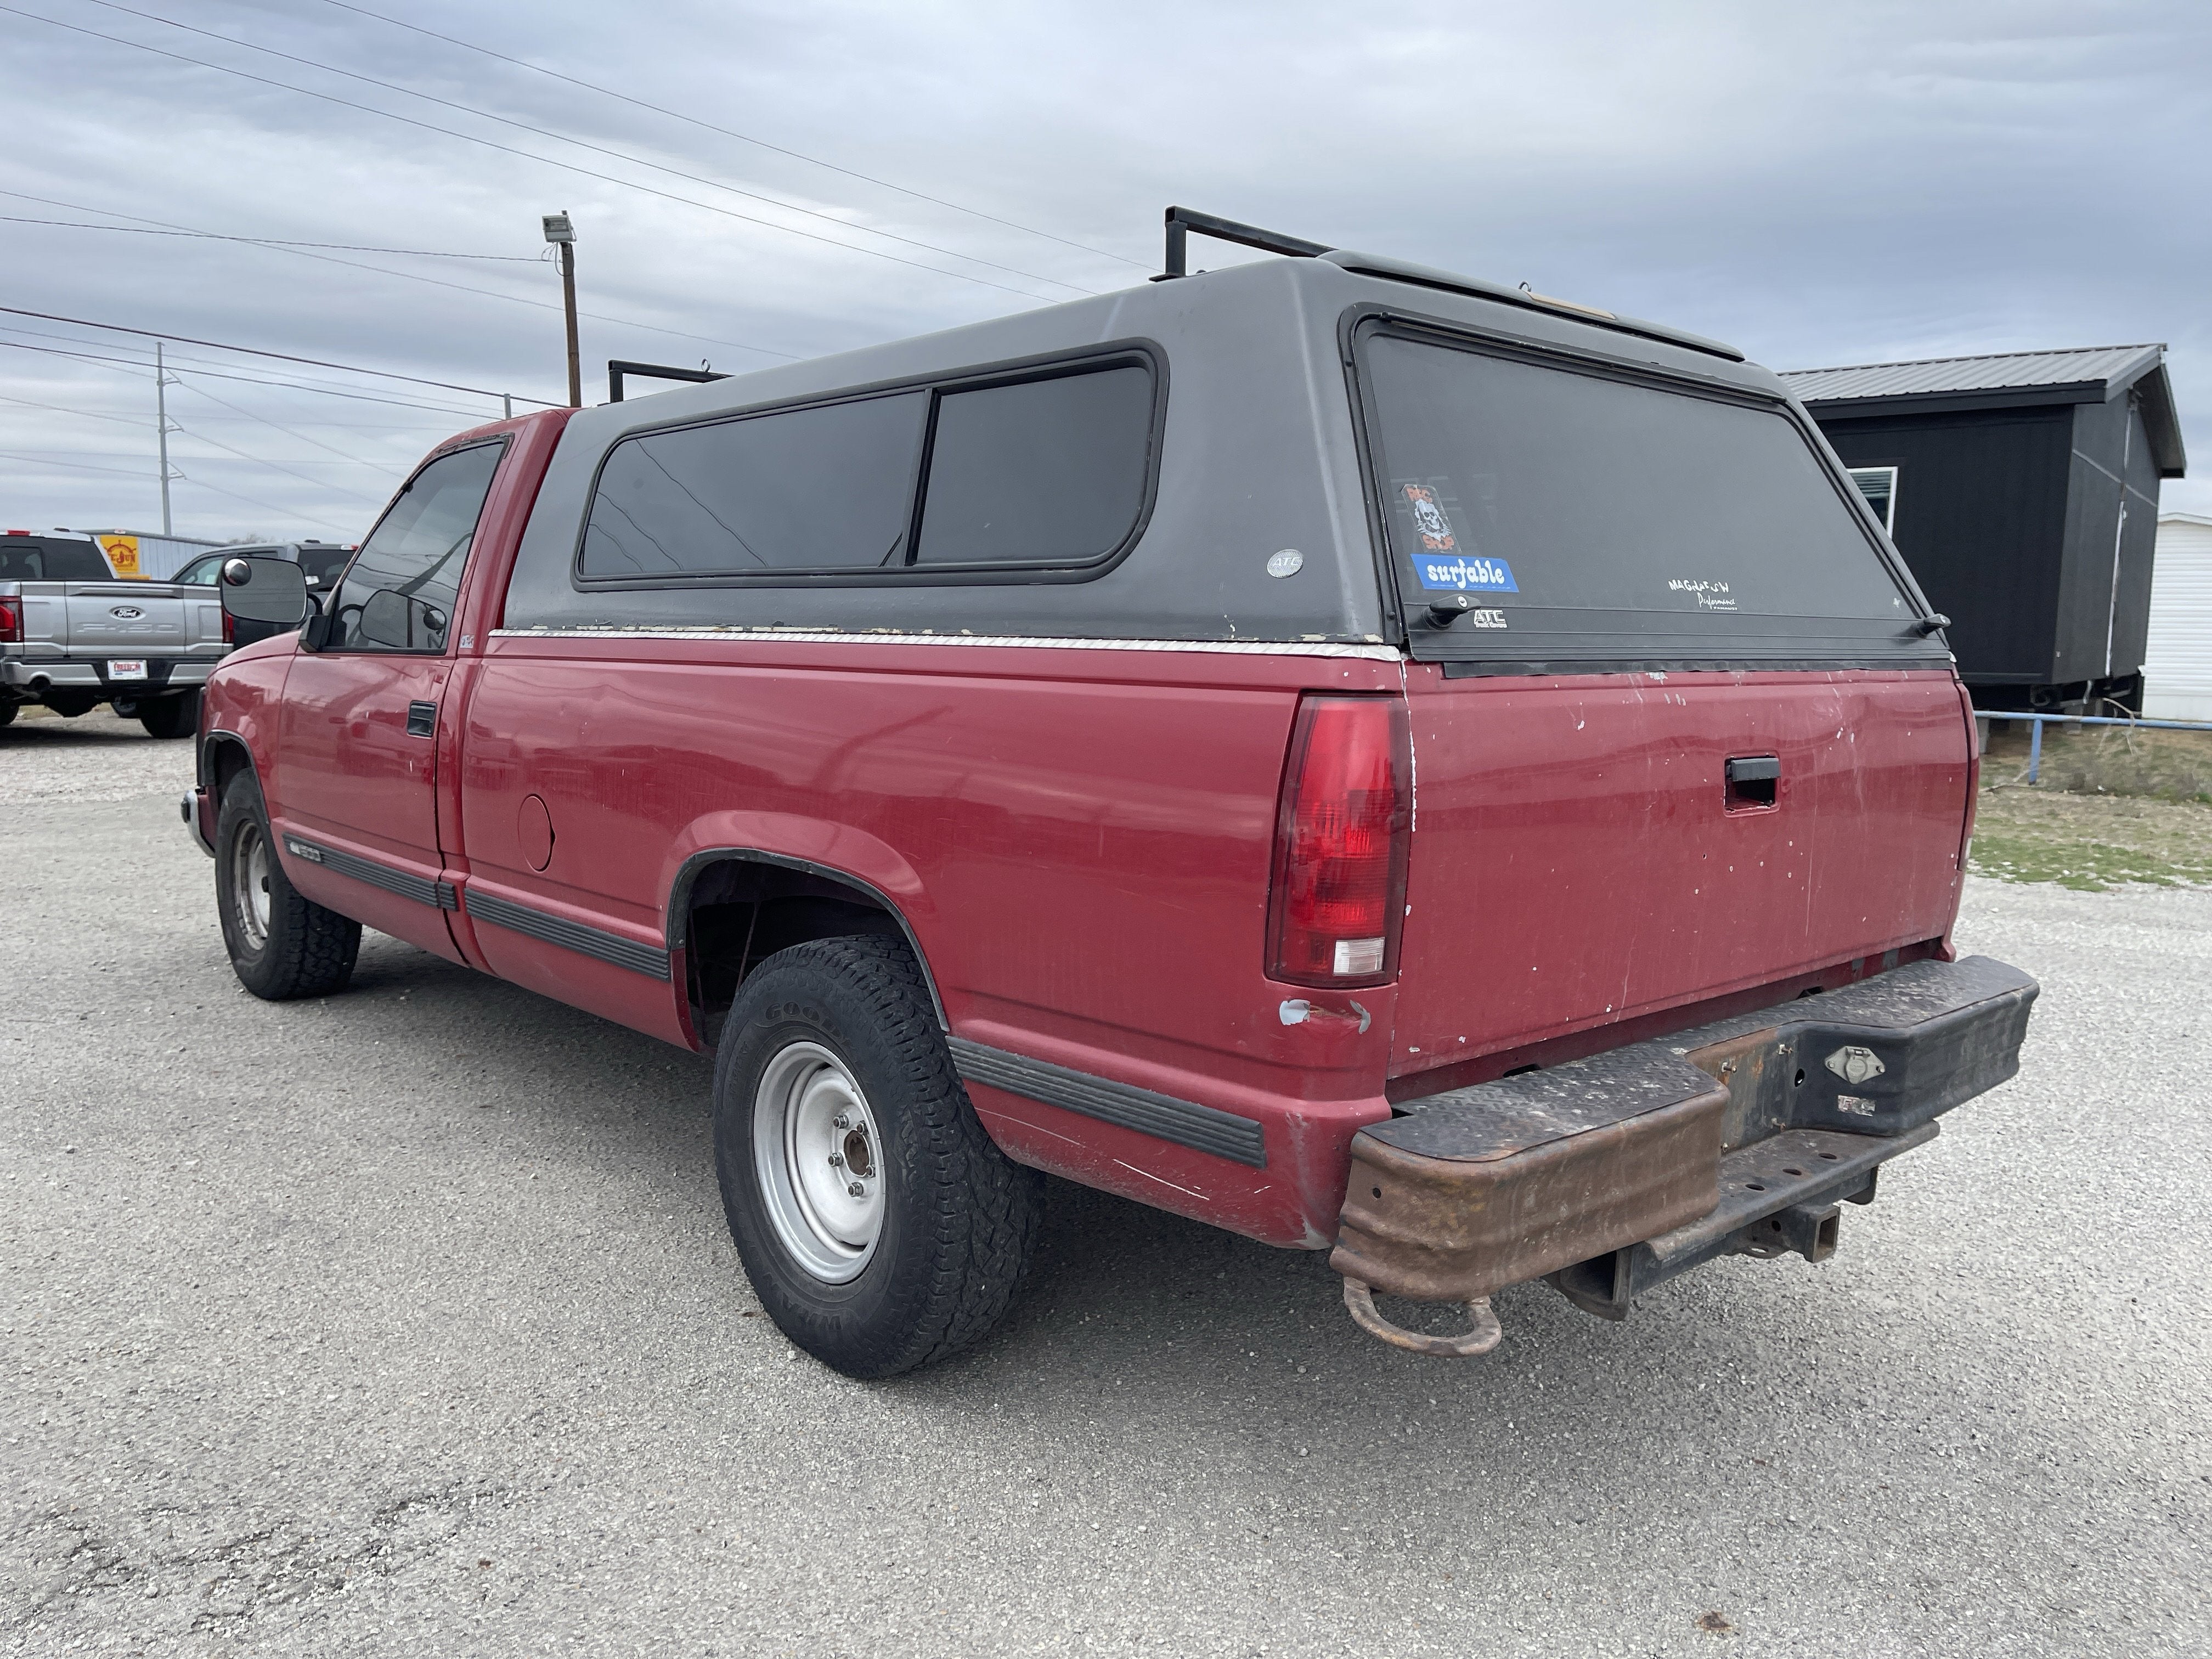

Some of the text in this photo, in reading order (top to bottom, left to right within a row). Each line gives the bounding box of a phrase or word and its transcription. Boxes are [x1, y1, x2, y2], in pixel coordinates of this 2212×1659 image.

[1272, 556, 1301, 567] ATC
[1427, 558, 1505, 589] surfable
[117, 609, 138, 618] Ford
[1474, 610, 1506, 624] ATC
